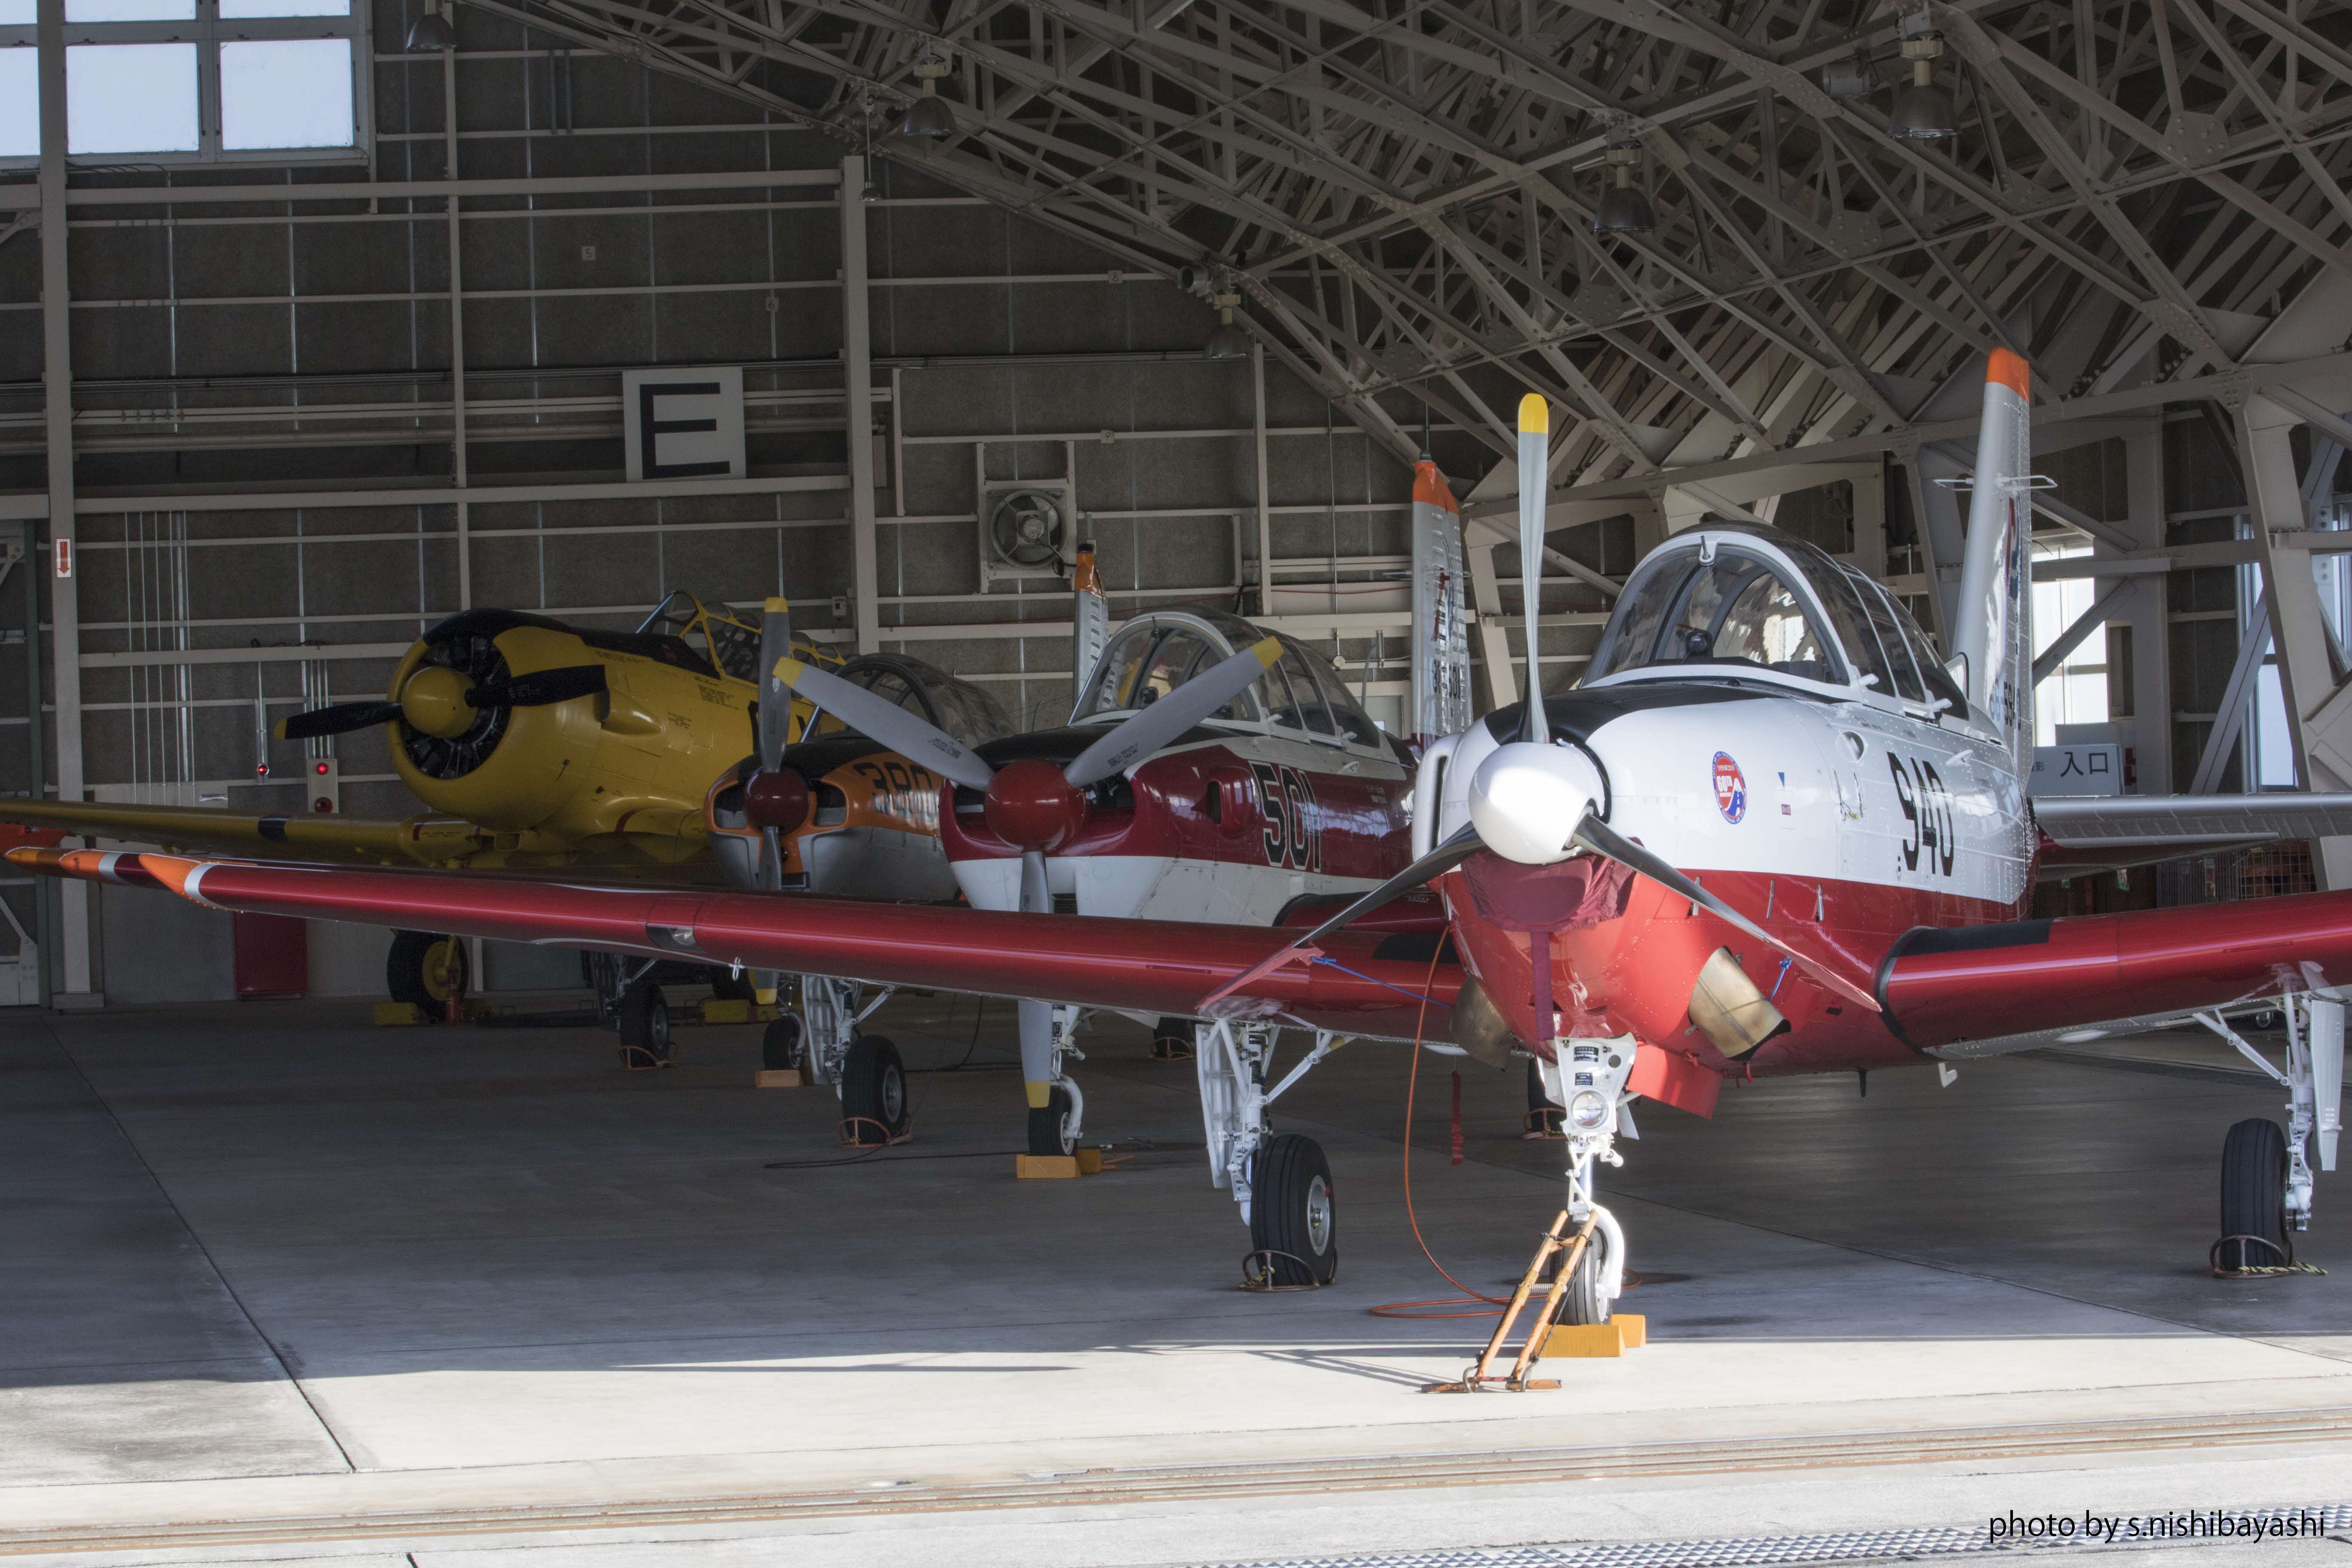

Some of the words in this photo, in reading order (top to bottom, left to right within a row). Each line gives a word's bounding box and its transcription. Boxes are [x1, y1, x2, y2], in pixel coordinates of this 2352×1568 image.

[585, 248, 592, 258] 5
[769, 300, 775, 309] 6
[640, 382, 731, 480] E
[2060, 751, 2108, 778] 入口
[1248, 760, 1321, 873] 501
[1886, 751, 1954, 877] 940
